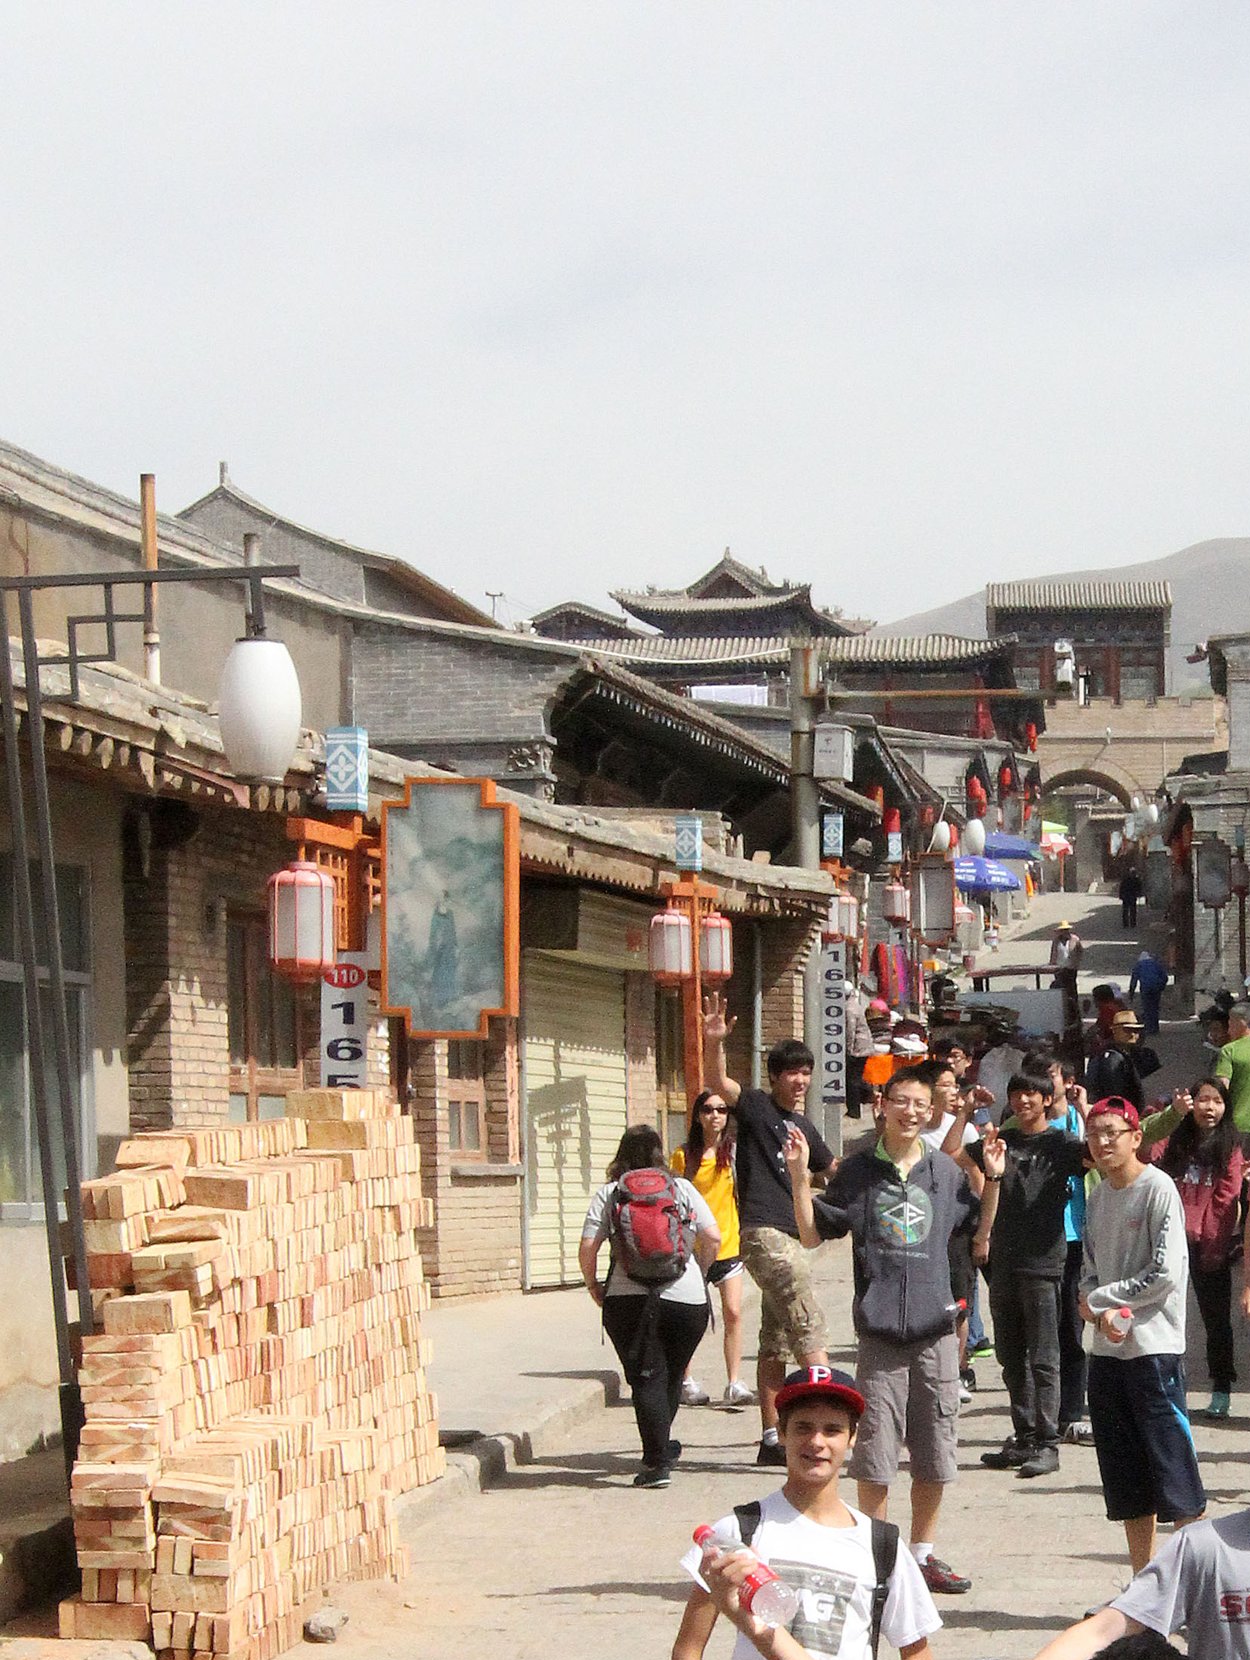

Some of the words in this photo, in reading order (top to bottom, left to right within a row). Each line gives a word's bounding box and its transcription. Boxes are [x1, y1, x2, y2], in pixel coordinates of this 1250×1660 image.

[332, 969, 359, 984] 110
[824, 950, 844, 1091] 16509004
[808, 1365, 832, 1385] P
